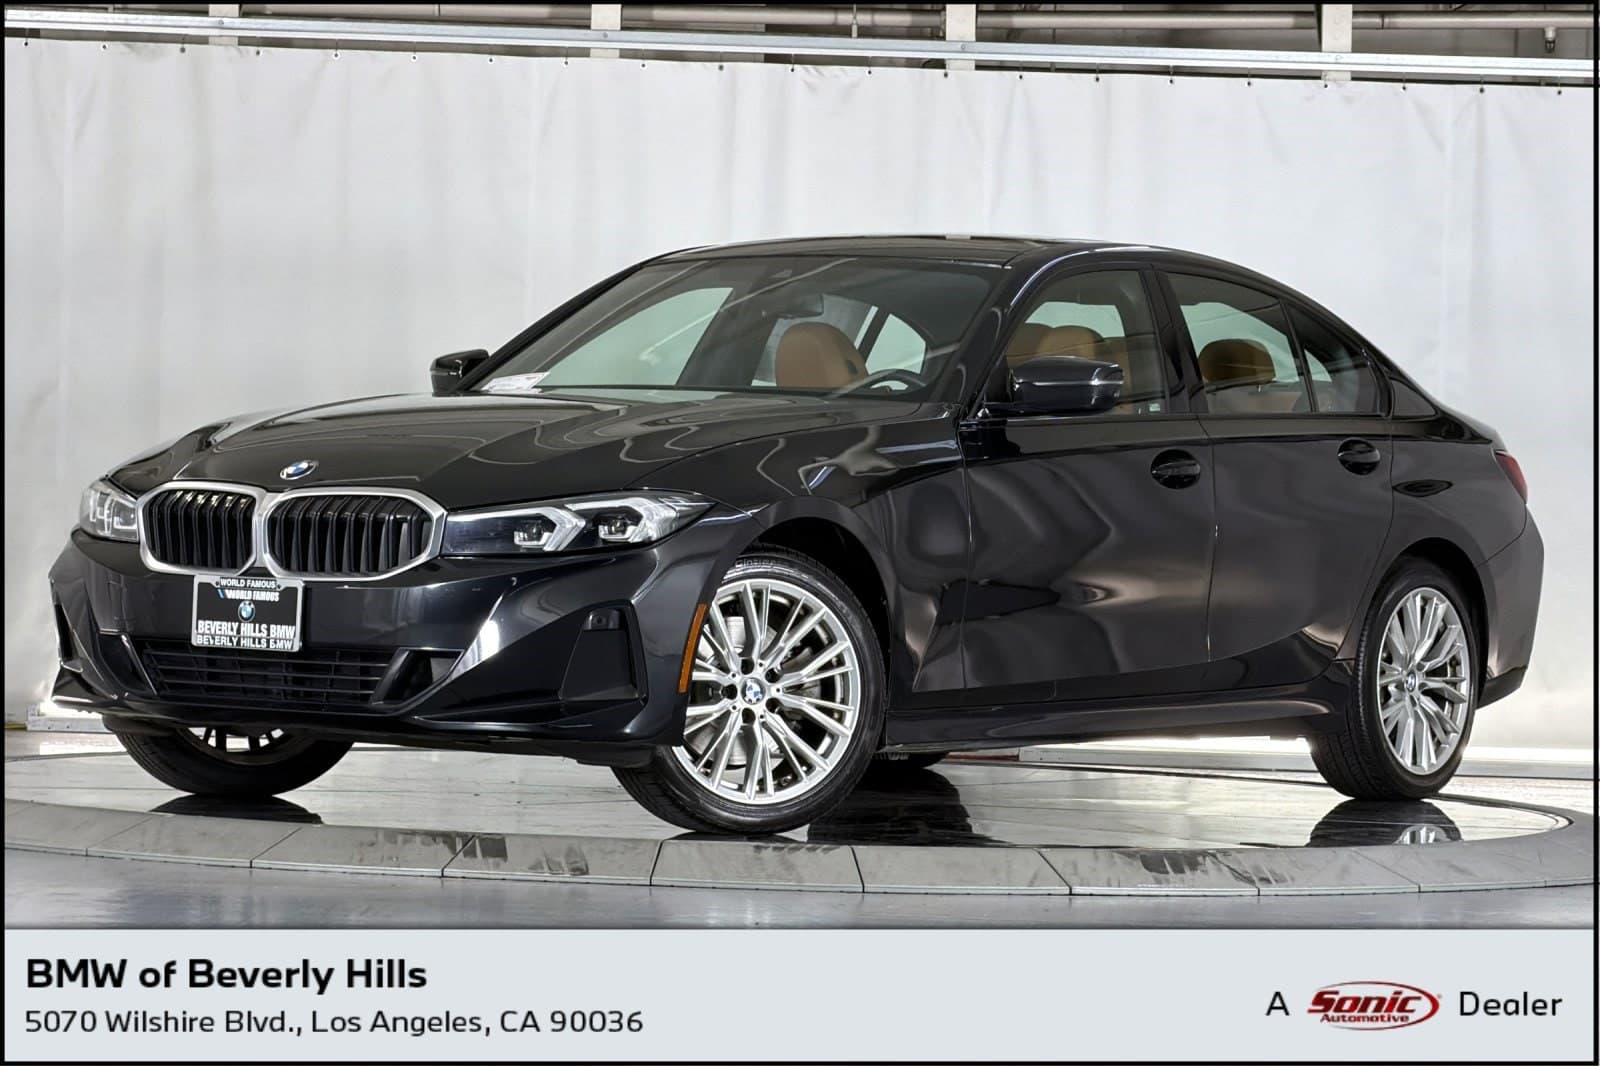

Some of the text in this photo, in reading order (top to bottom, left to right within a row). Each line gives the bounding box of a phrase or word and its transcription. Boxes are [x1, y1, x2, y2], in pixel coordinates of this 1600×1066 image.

[220, 578, 276, 588] WORLD FAMOUS
[224, 589, 280, 602] WORLD FAMOUS
[198, 620, 296, 639] BEVERLY HILLS BMW
[197, 635, 238, 646] BEVERLY
[240, 637, 267, 648] HILLS
